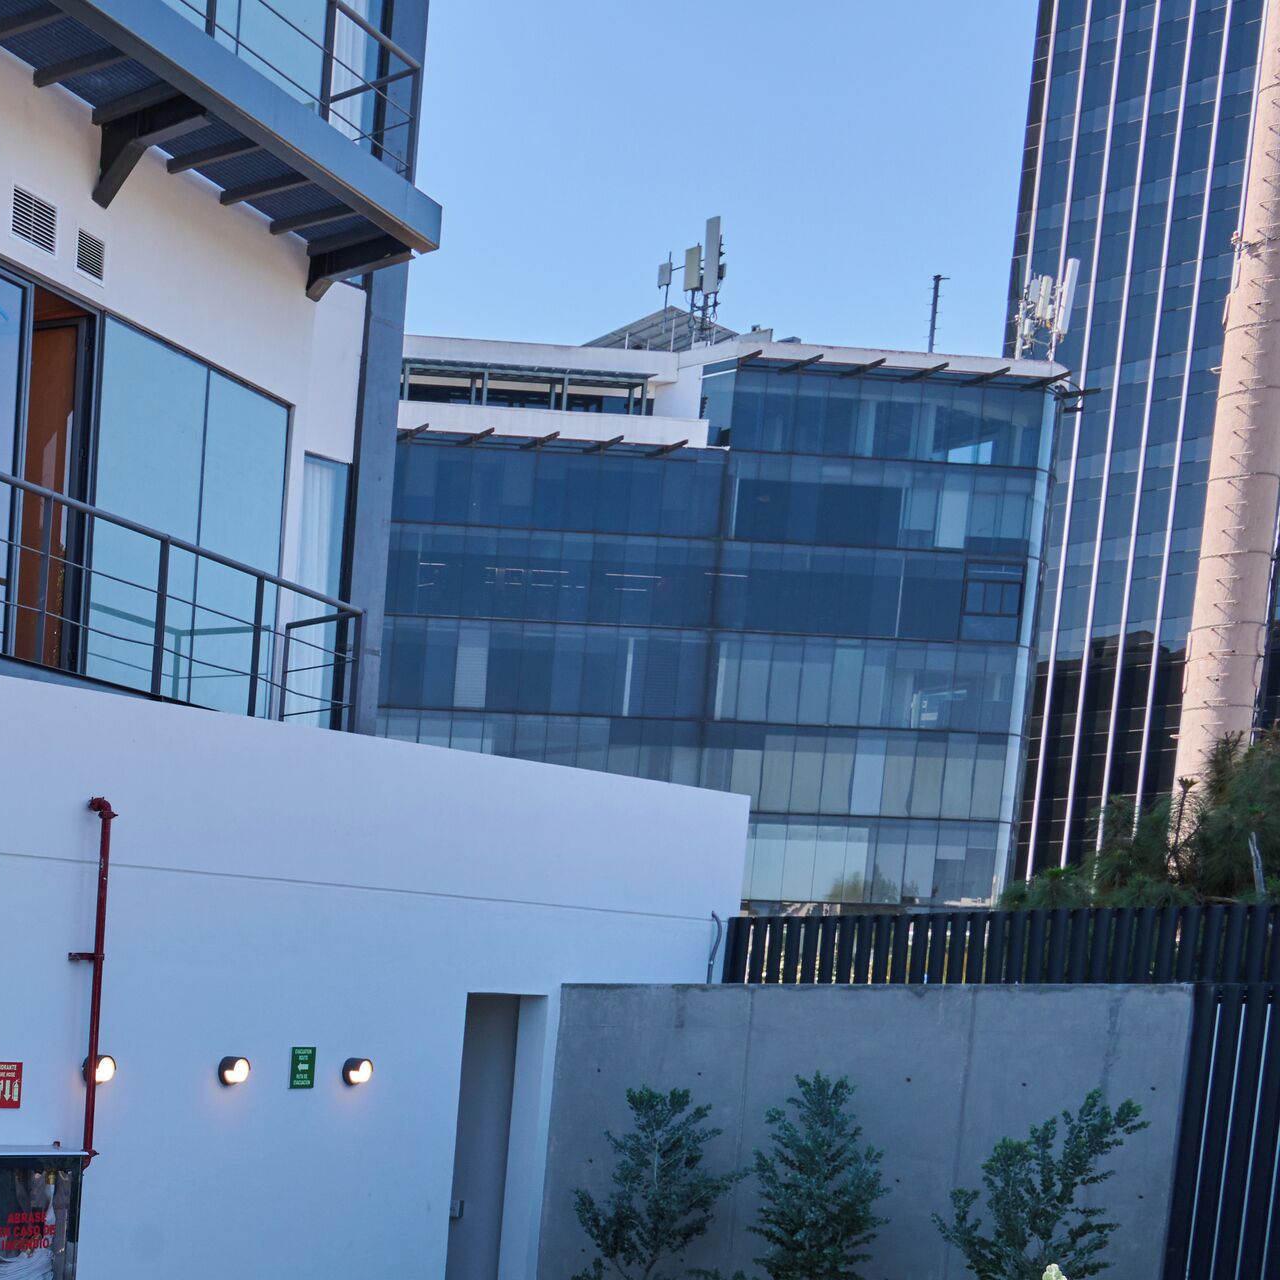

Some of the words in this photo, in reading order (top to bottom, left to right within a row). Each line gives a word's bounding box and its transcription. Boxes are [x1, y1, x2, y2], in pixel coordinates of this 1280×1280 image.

[7, 1211, 47, 1224] ABRASE
[13, 1225, 40, 1237] CASO
[44, 1224, 57, 1236] DE
[1, 1238, 50, 1251] INCENDIO
